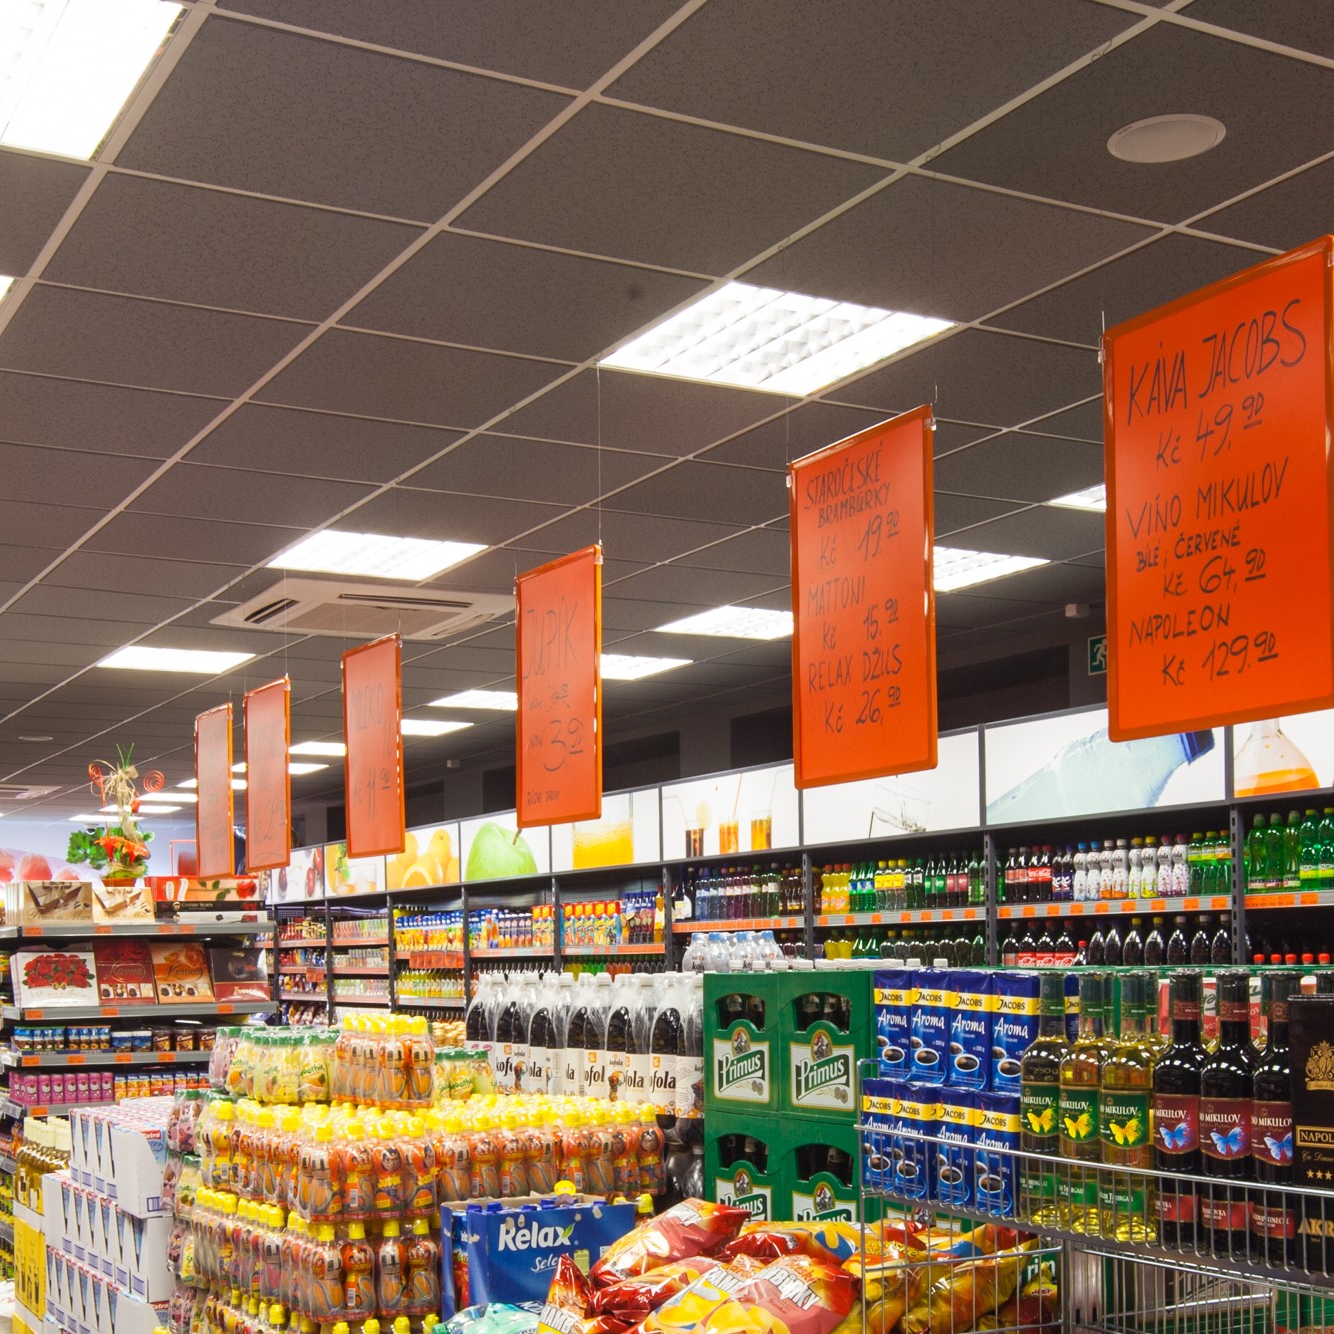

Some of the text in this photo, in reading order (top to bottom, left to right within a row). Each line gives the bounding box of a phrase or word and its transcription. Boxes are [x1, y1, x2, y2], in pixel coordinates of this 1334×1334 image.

[1127, 300, 1307, 425] KÁVA JACOBS
[1156, 427, 1181, 469] Kč
[804, 441, 884, 511] STAROČESKÉ
[1126, 457, 1288, 539] VÍNO MIKULOV
[1173, 524, 1242, 558] ČERVENÉ
[806, 574, 866, 621] MATTONI
[1164, 567, 1188, 598] Kč
[1129, 603, 1231, 647] NAPOLEON
[807, 644, 903, 695] RELAX DŽUS
[1161, 655, 1187, 686] Kč
[879, 992, 903, 1002] JACOBS
[917, 991, 942, 1002] JACOBS
[955, 996, 983, 1007] JACOBS
[878, 1009, 907, 1028] Aroma
[912, 1009, 945, 1029] Aroma
[952, 1013, 985, 1034] Aroma
[720, 1053, 761, 1087] Primus
[798, 1058, 845, 1096] Primus
[1023, 1096, 1053, 1105] MIKULOV
[1104, 1104, 1138, 1116] MIKULOV
[498, 1222, 571, 1251] Relax
